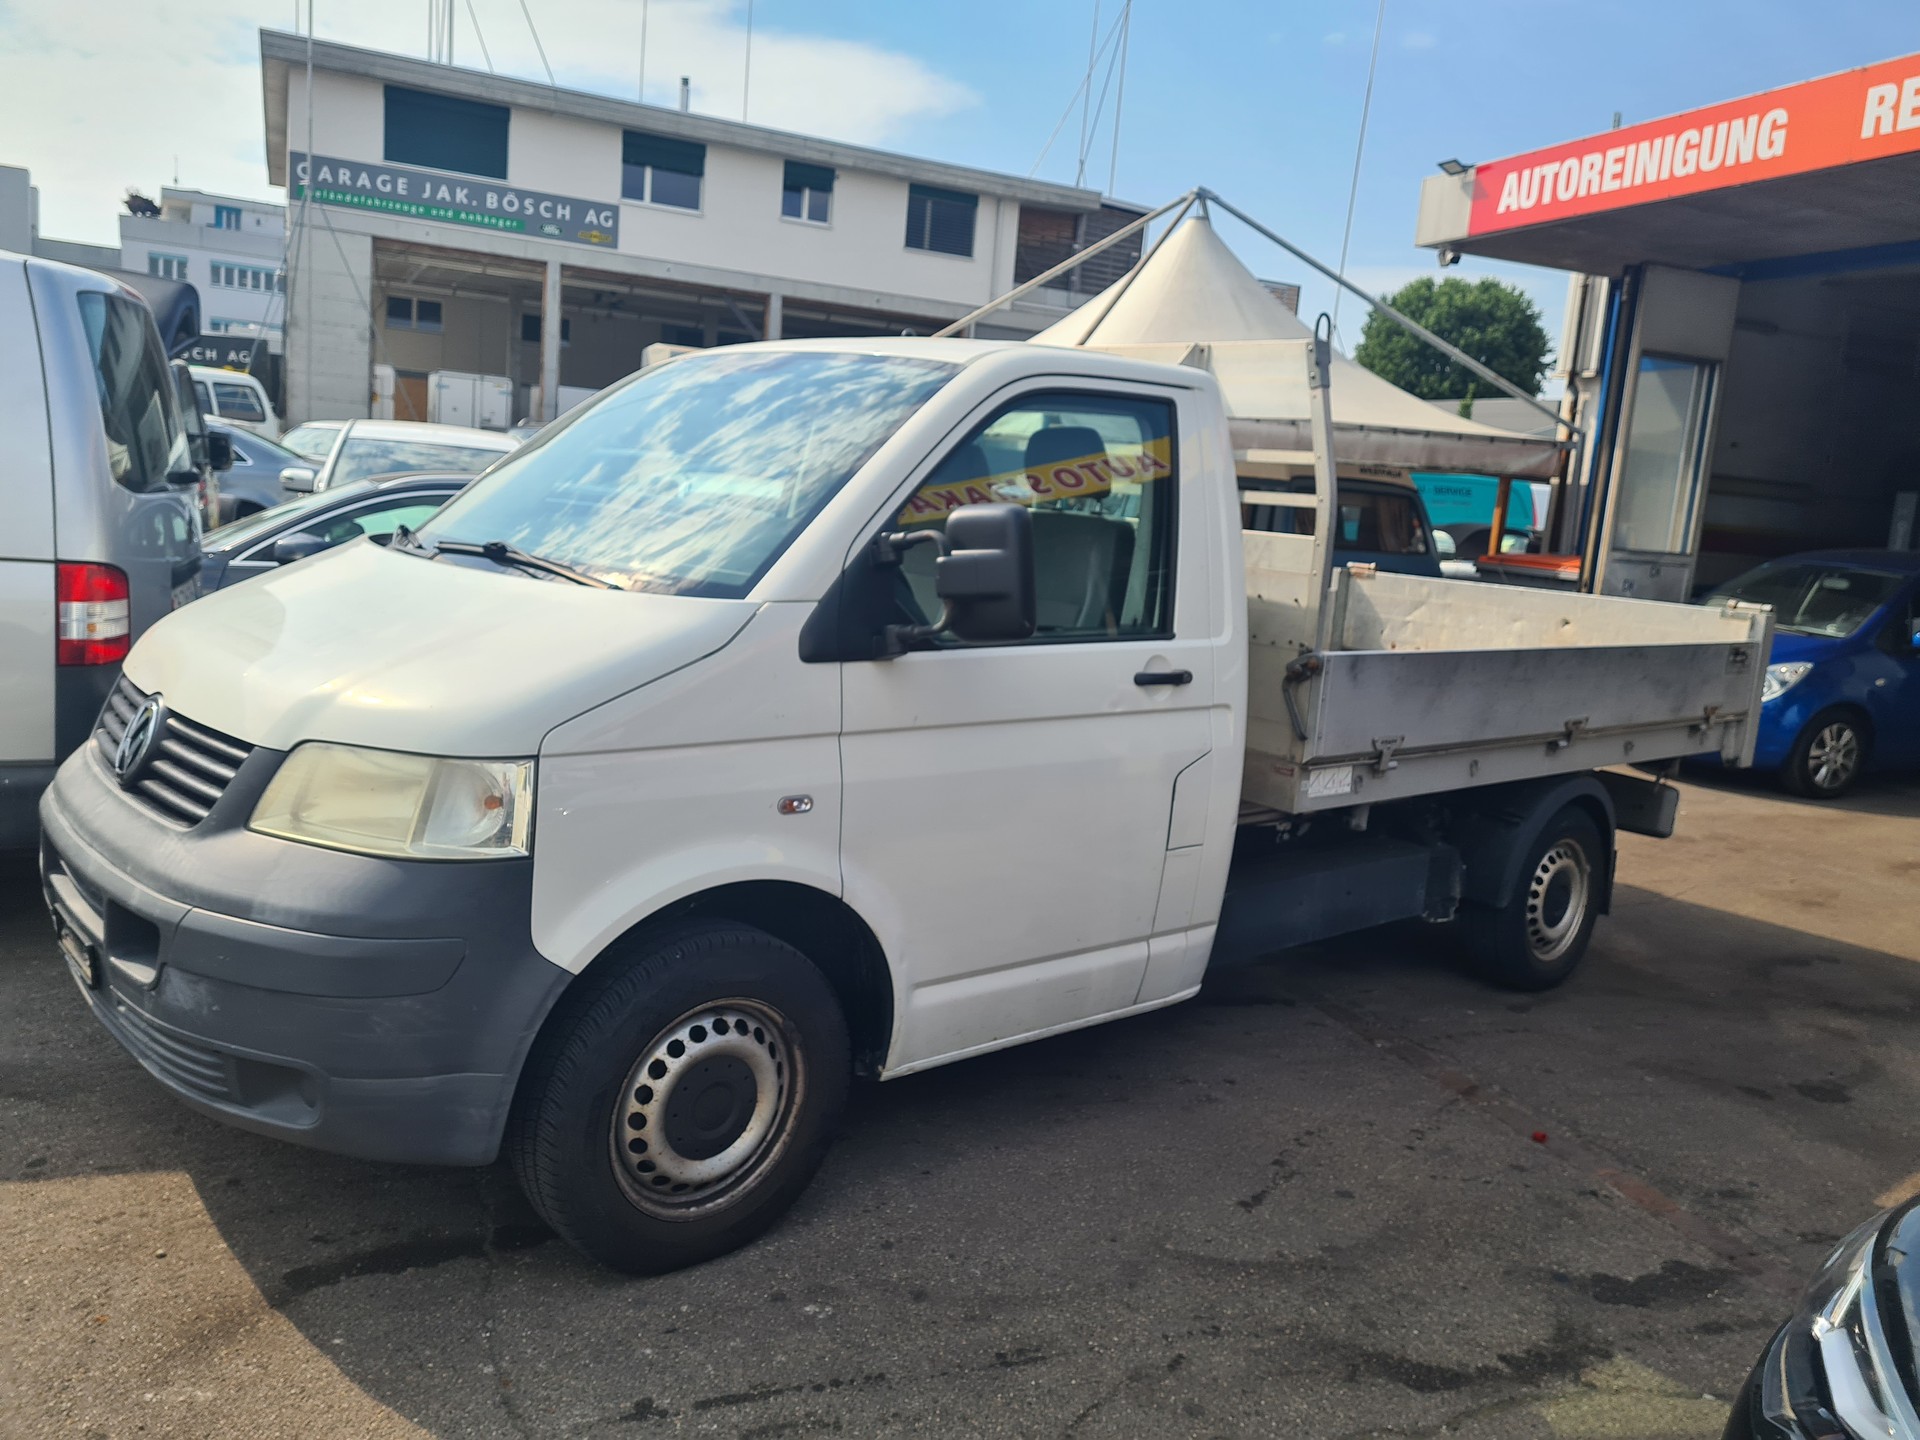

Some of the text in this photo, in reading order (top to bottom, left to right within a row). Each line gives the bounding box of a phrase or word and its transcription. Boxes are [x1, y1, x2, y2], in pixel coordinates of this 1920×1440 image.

[1497, 75, 1920, 214] AUTOREINIGUNG RE
[296, 161, 613, 228] GARAGE JAK. BÖSCH AG
[304, 187, 425, 214] eländefahrzeuge
[431, 208, 453, 219] und
